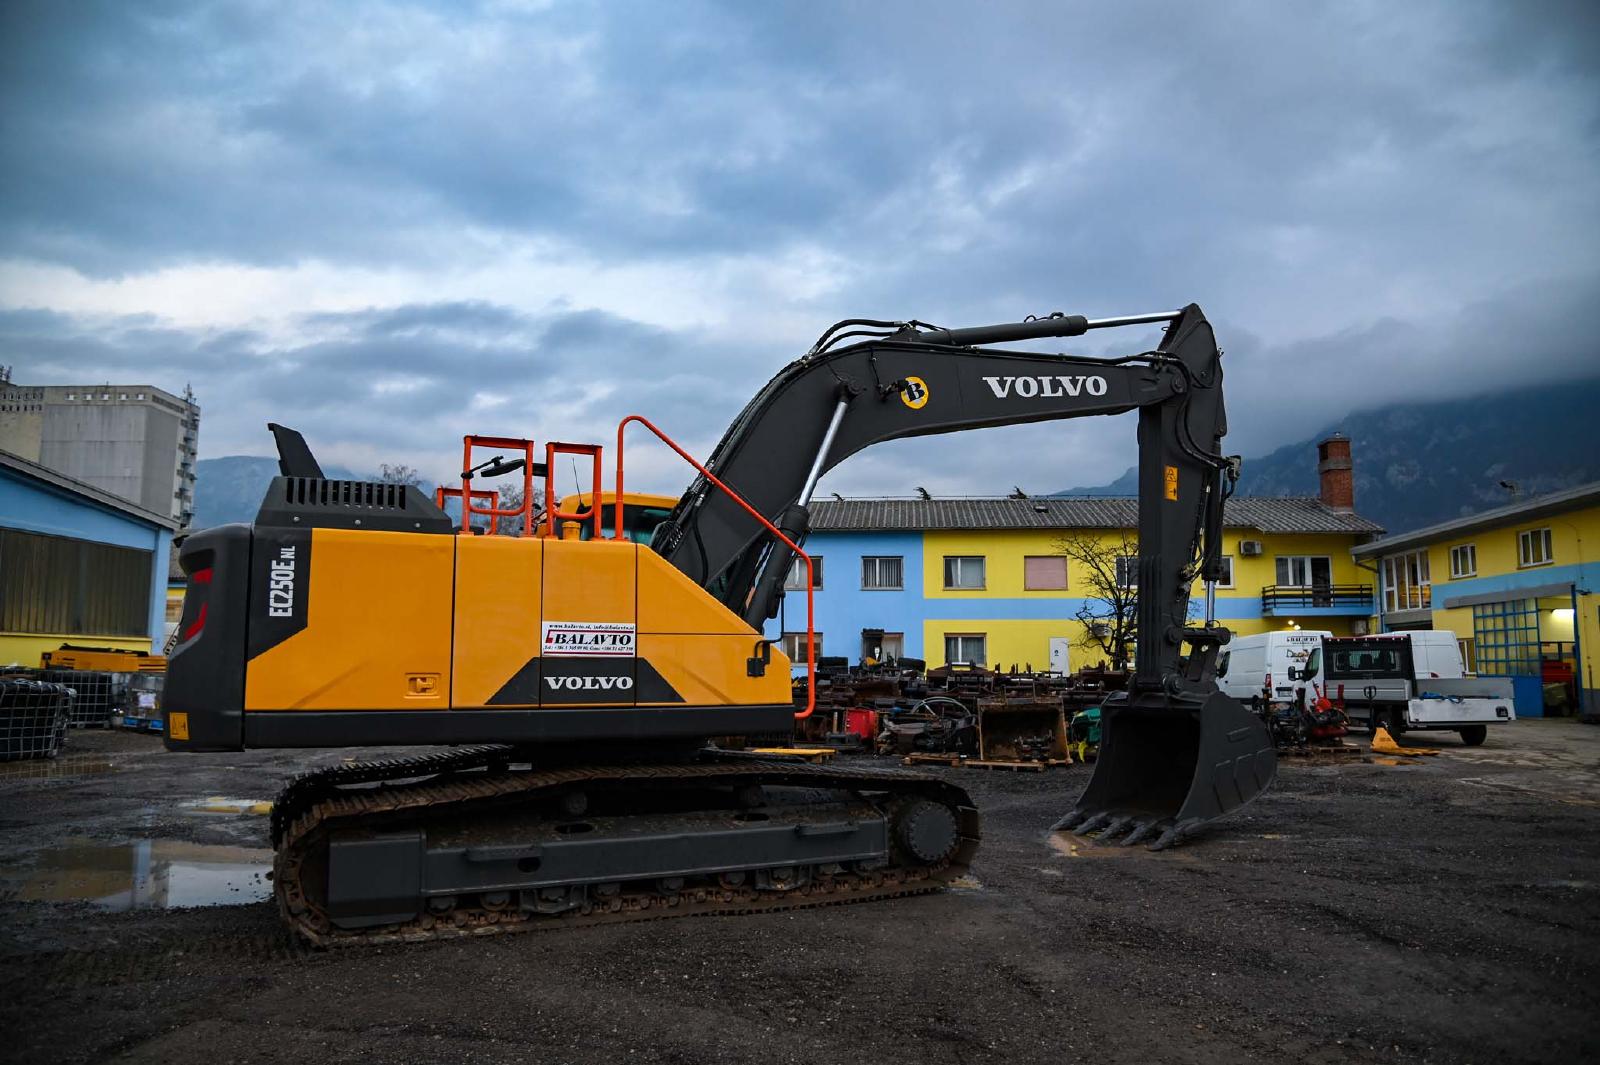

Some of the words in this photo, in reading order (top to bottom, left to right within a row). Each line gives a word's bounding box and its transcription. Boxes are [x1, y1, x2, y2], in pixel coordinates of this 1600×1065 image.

[907, 382, 925, 402] B
[982, 376, 1108, 399] VOLVO
[555, 633, 632, 646] BALAVTO
[543, 676, 634, 690] VOLVO
